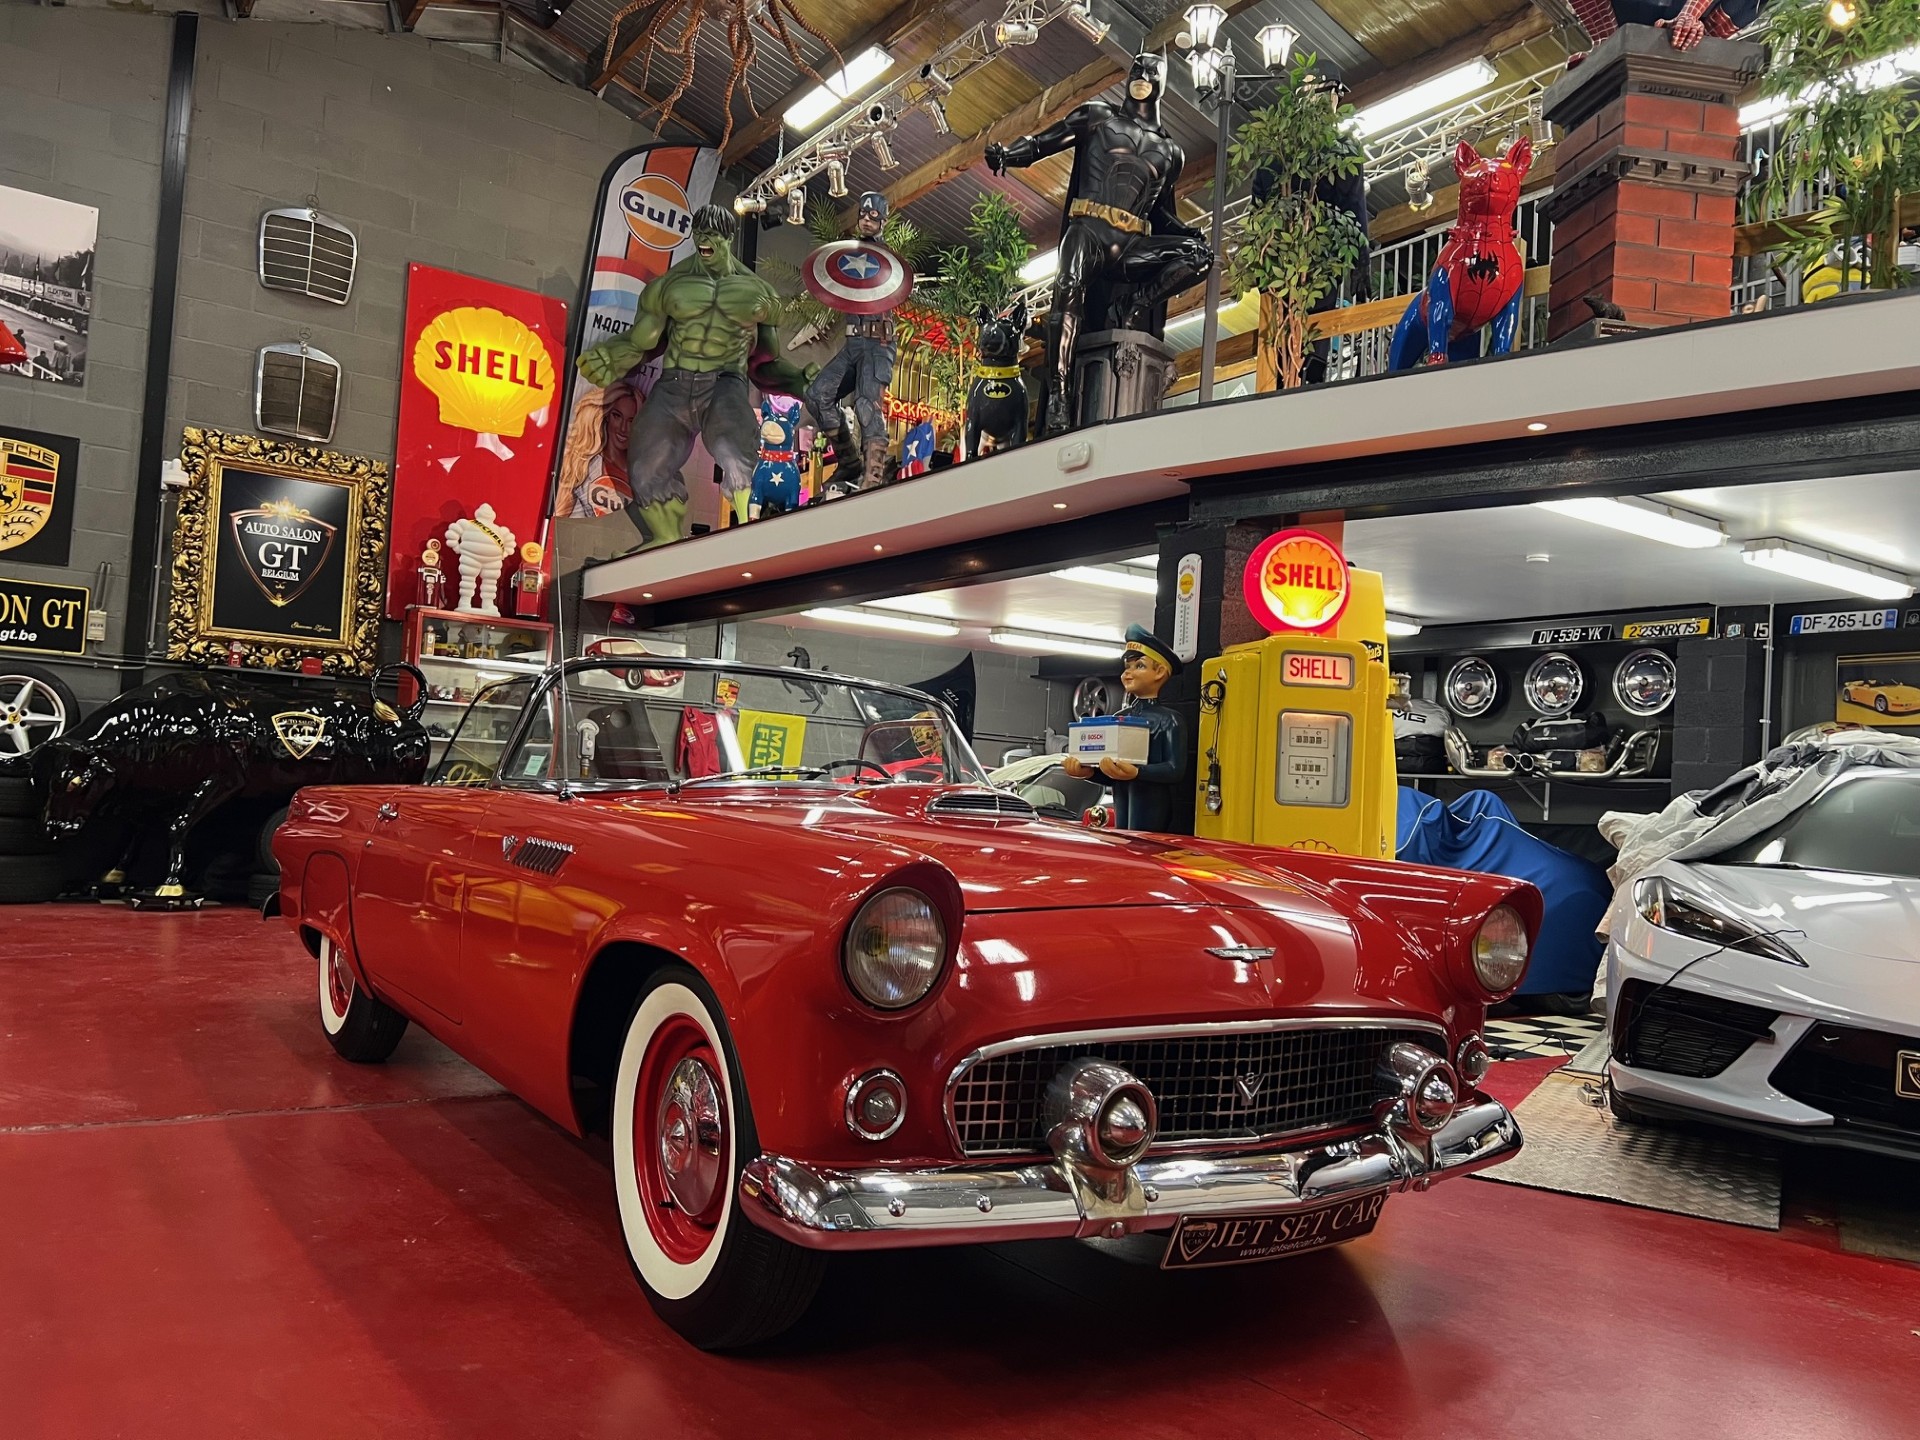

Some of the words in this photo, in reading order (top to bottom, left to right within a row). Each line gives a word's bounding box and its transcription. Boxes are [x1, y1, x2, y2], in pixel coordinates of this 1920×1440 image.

[623, 190, 691, 234] Gulf
[592, 313, 634, 335] MART
[434, 340, 543, 391] SHELL
[244, 521, 280, 536] AUTO
[282, 526, 321, 542] SALON
[258, 541, 308, 571] GT
[261, 568, 300, 581] BELGIUM
[1272, 562, 1337, 591] SHELL
[42, 598, 81, 630] GT
[1802, 612, 1883, 631] DF-265-LG
[1538, 627, 1603, 644] DV-538-YK
[1289, 657, 1342, 680] SHELL
[1211, 1219, 1273, 1248] JET
[1273, 1209, 1331, 1243] SET
[1331, 1194, 1383, 1230] CAR
[1240, 1235, 1327, 1257] www.jetsetcar.be
